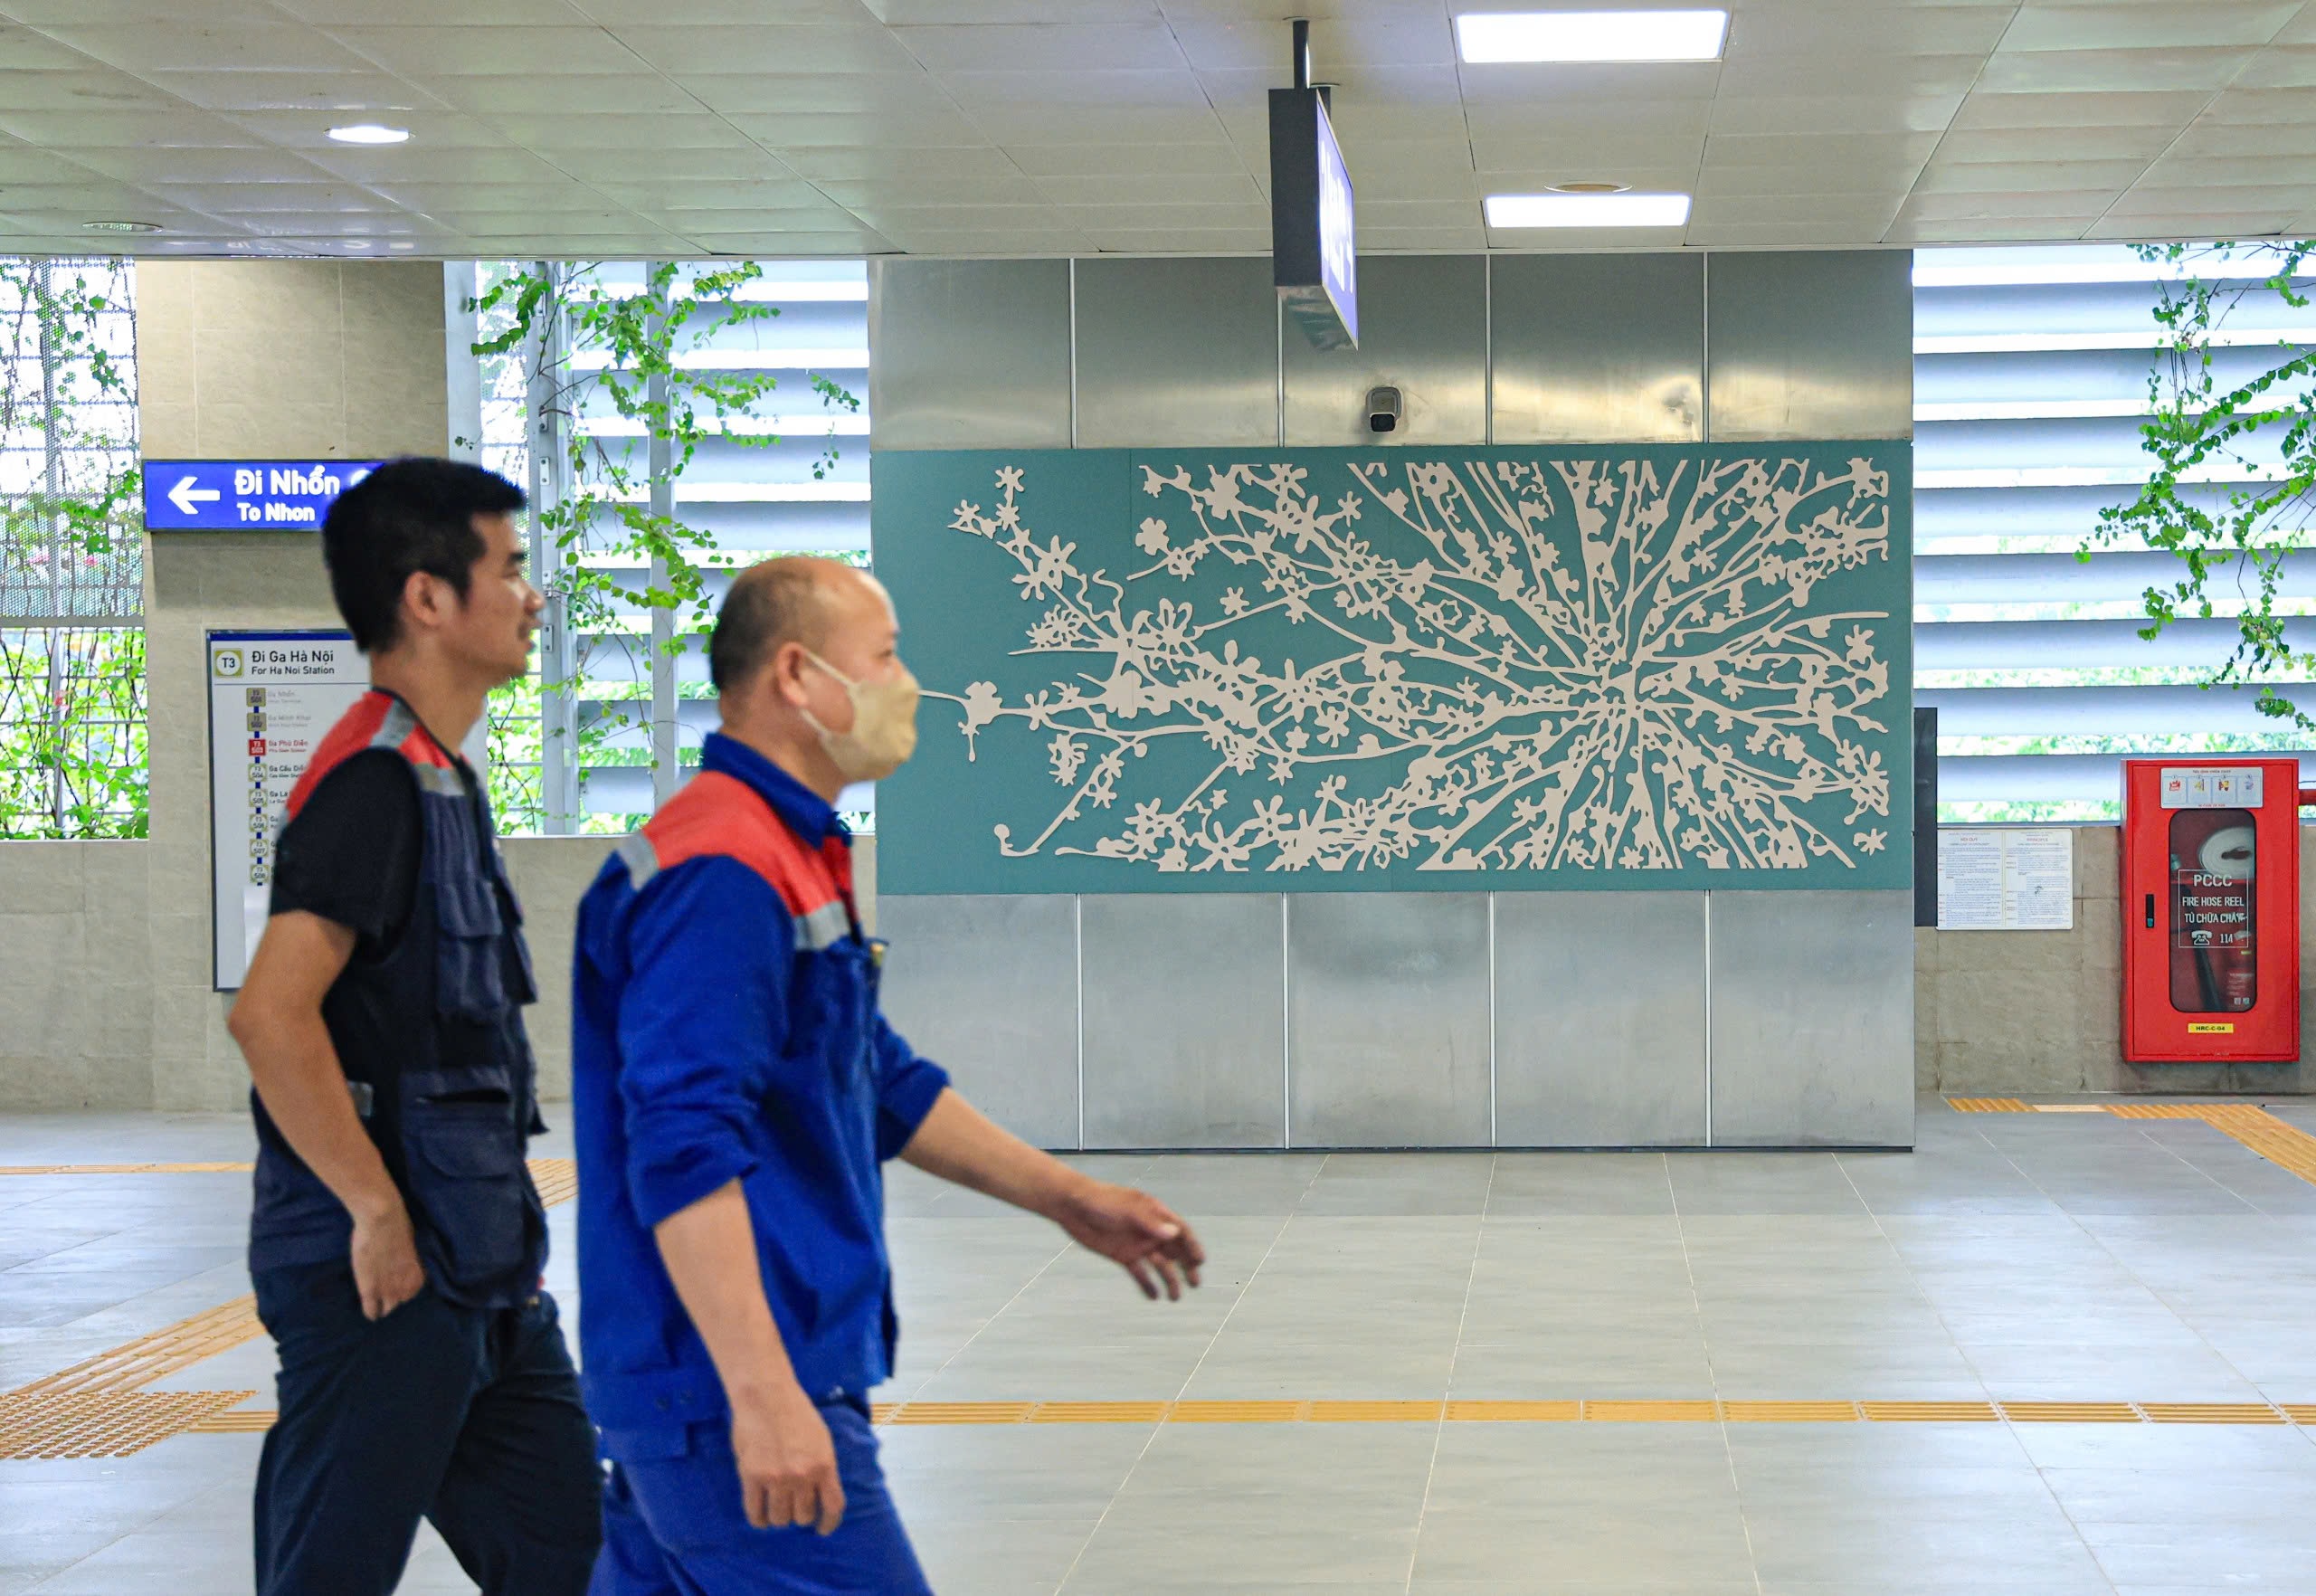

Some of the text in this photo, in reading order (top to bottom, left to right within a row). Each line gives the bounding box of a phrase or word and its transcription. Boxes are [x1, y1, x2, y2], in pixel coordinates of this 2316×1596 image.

[234, 464, 340, 496] Đi Nhổn
[237, 502, 316, 522] To Nhon
[222, 657, 235, 669] T3
[252, 650, 334, 665] Đi Ga Hà Nội
[252, 666, 335, 675] For Ha Noi Station
[2193, 874, 2233, 887] PCCC
[2182, 896, 2245, 907] FIRE HOSE REEL
[2220, 933, 2233, 944] 114
